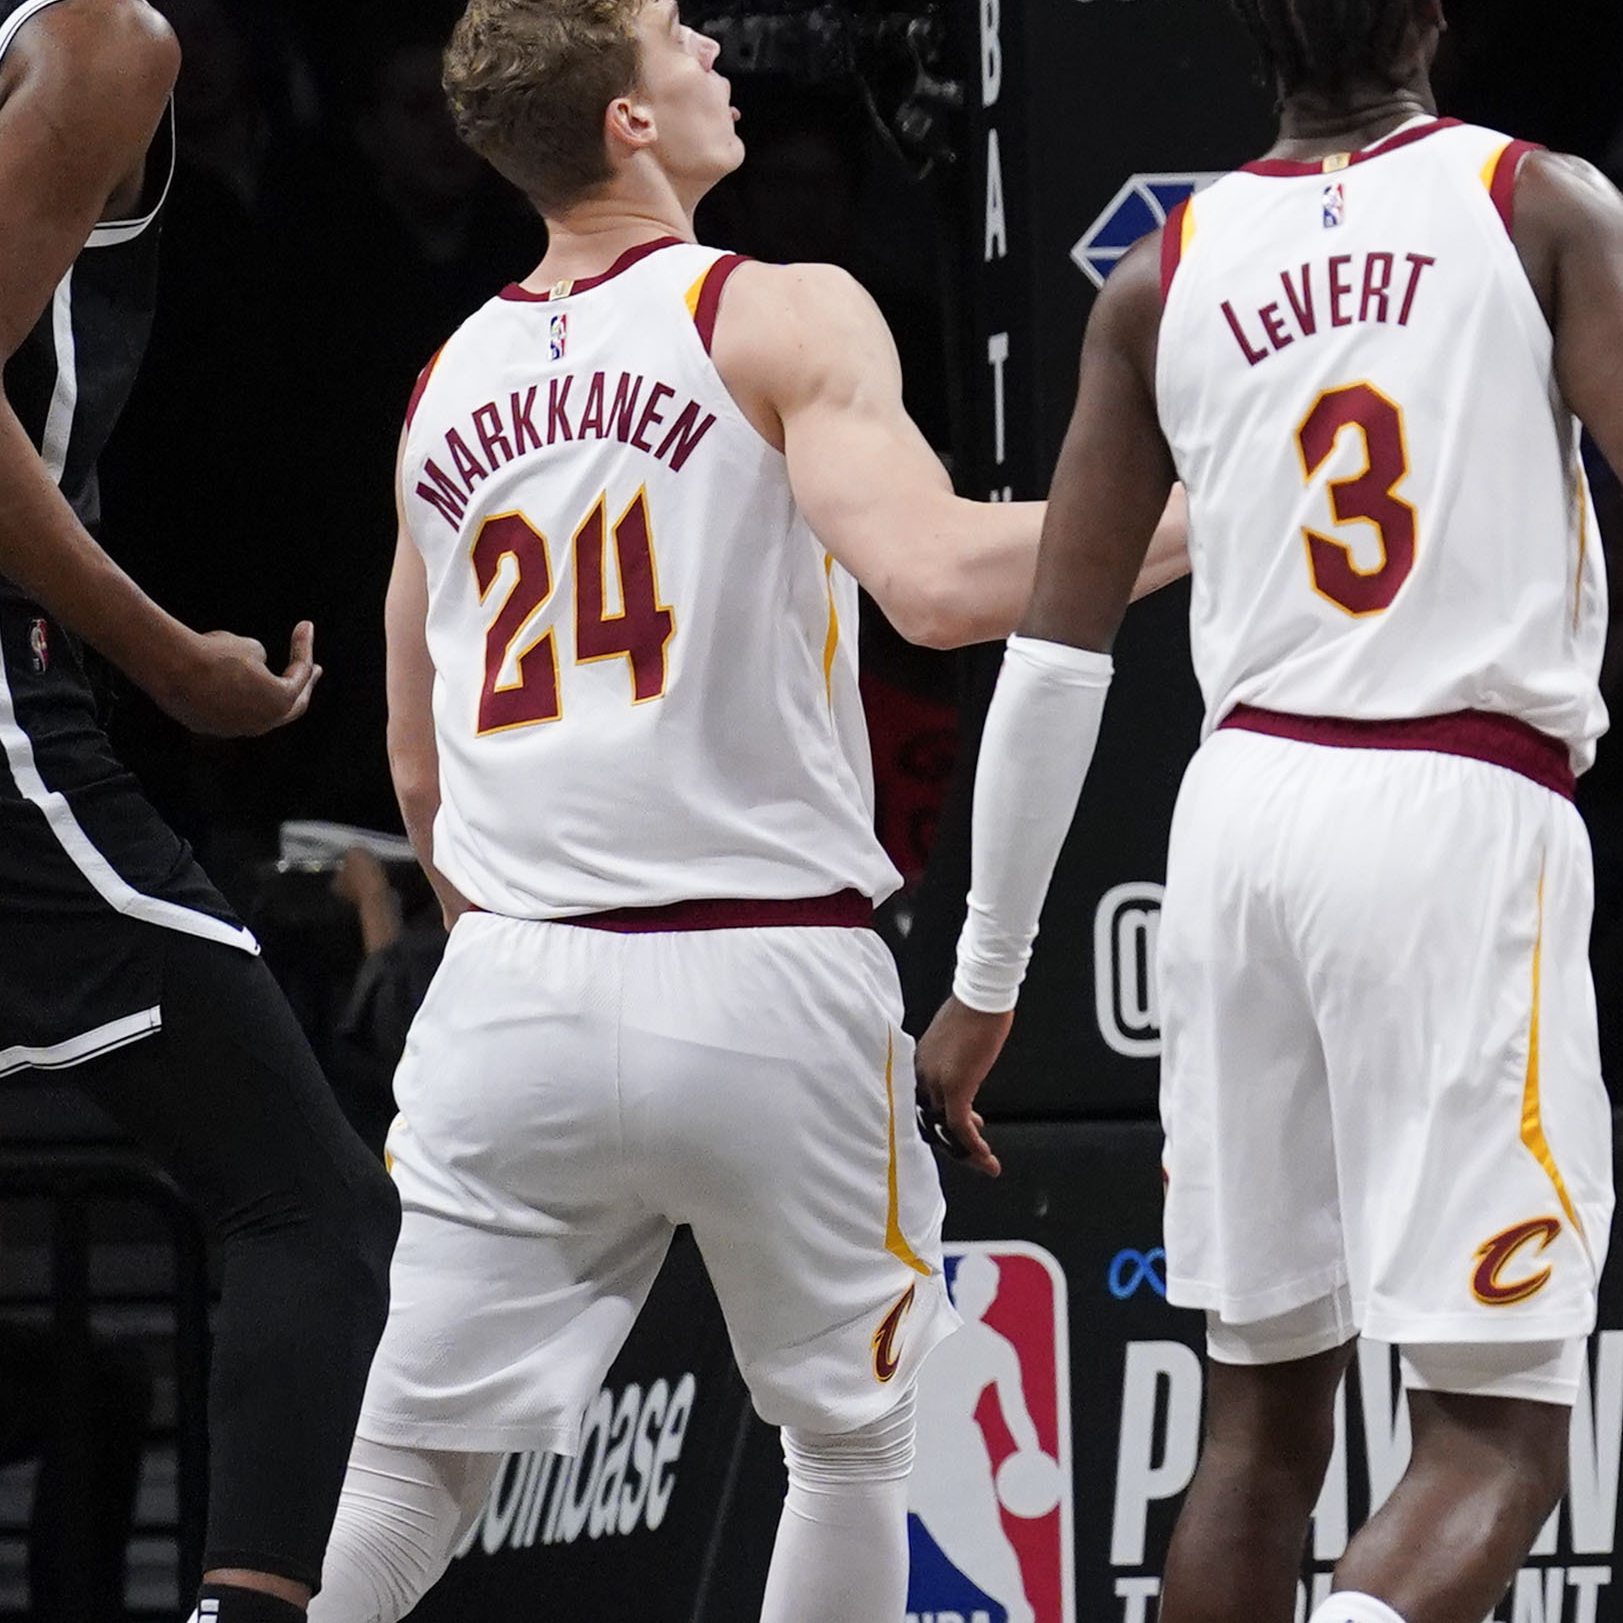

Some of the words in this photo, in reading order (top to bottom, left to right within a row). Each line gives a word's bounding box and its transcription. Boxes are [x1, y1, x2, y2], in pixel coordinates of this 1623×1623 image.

[415, 371, 717, 532] MARKKANEN
[1293, 379, 1419, 619] 3
[471, 482, 678, 736] 24
[1470, 1215, 1562, 1308] C
[456, 1372, 696, 1559] oinbase
